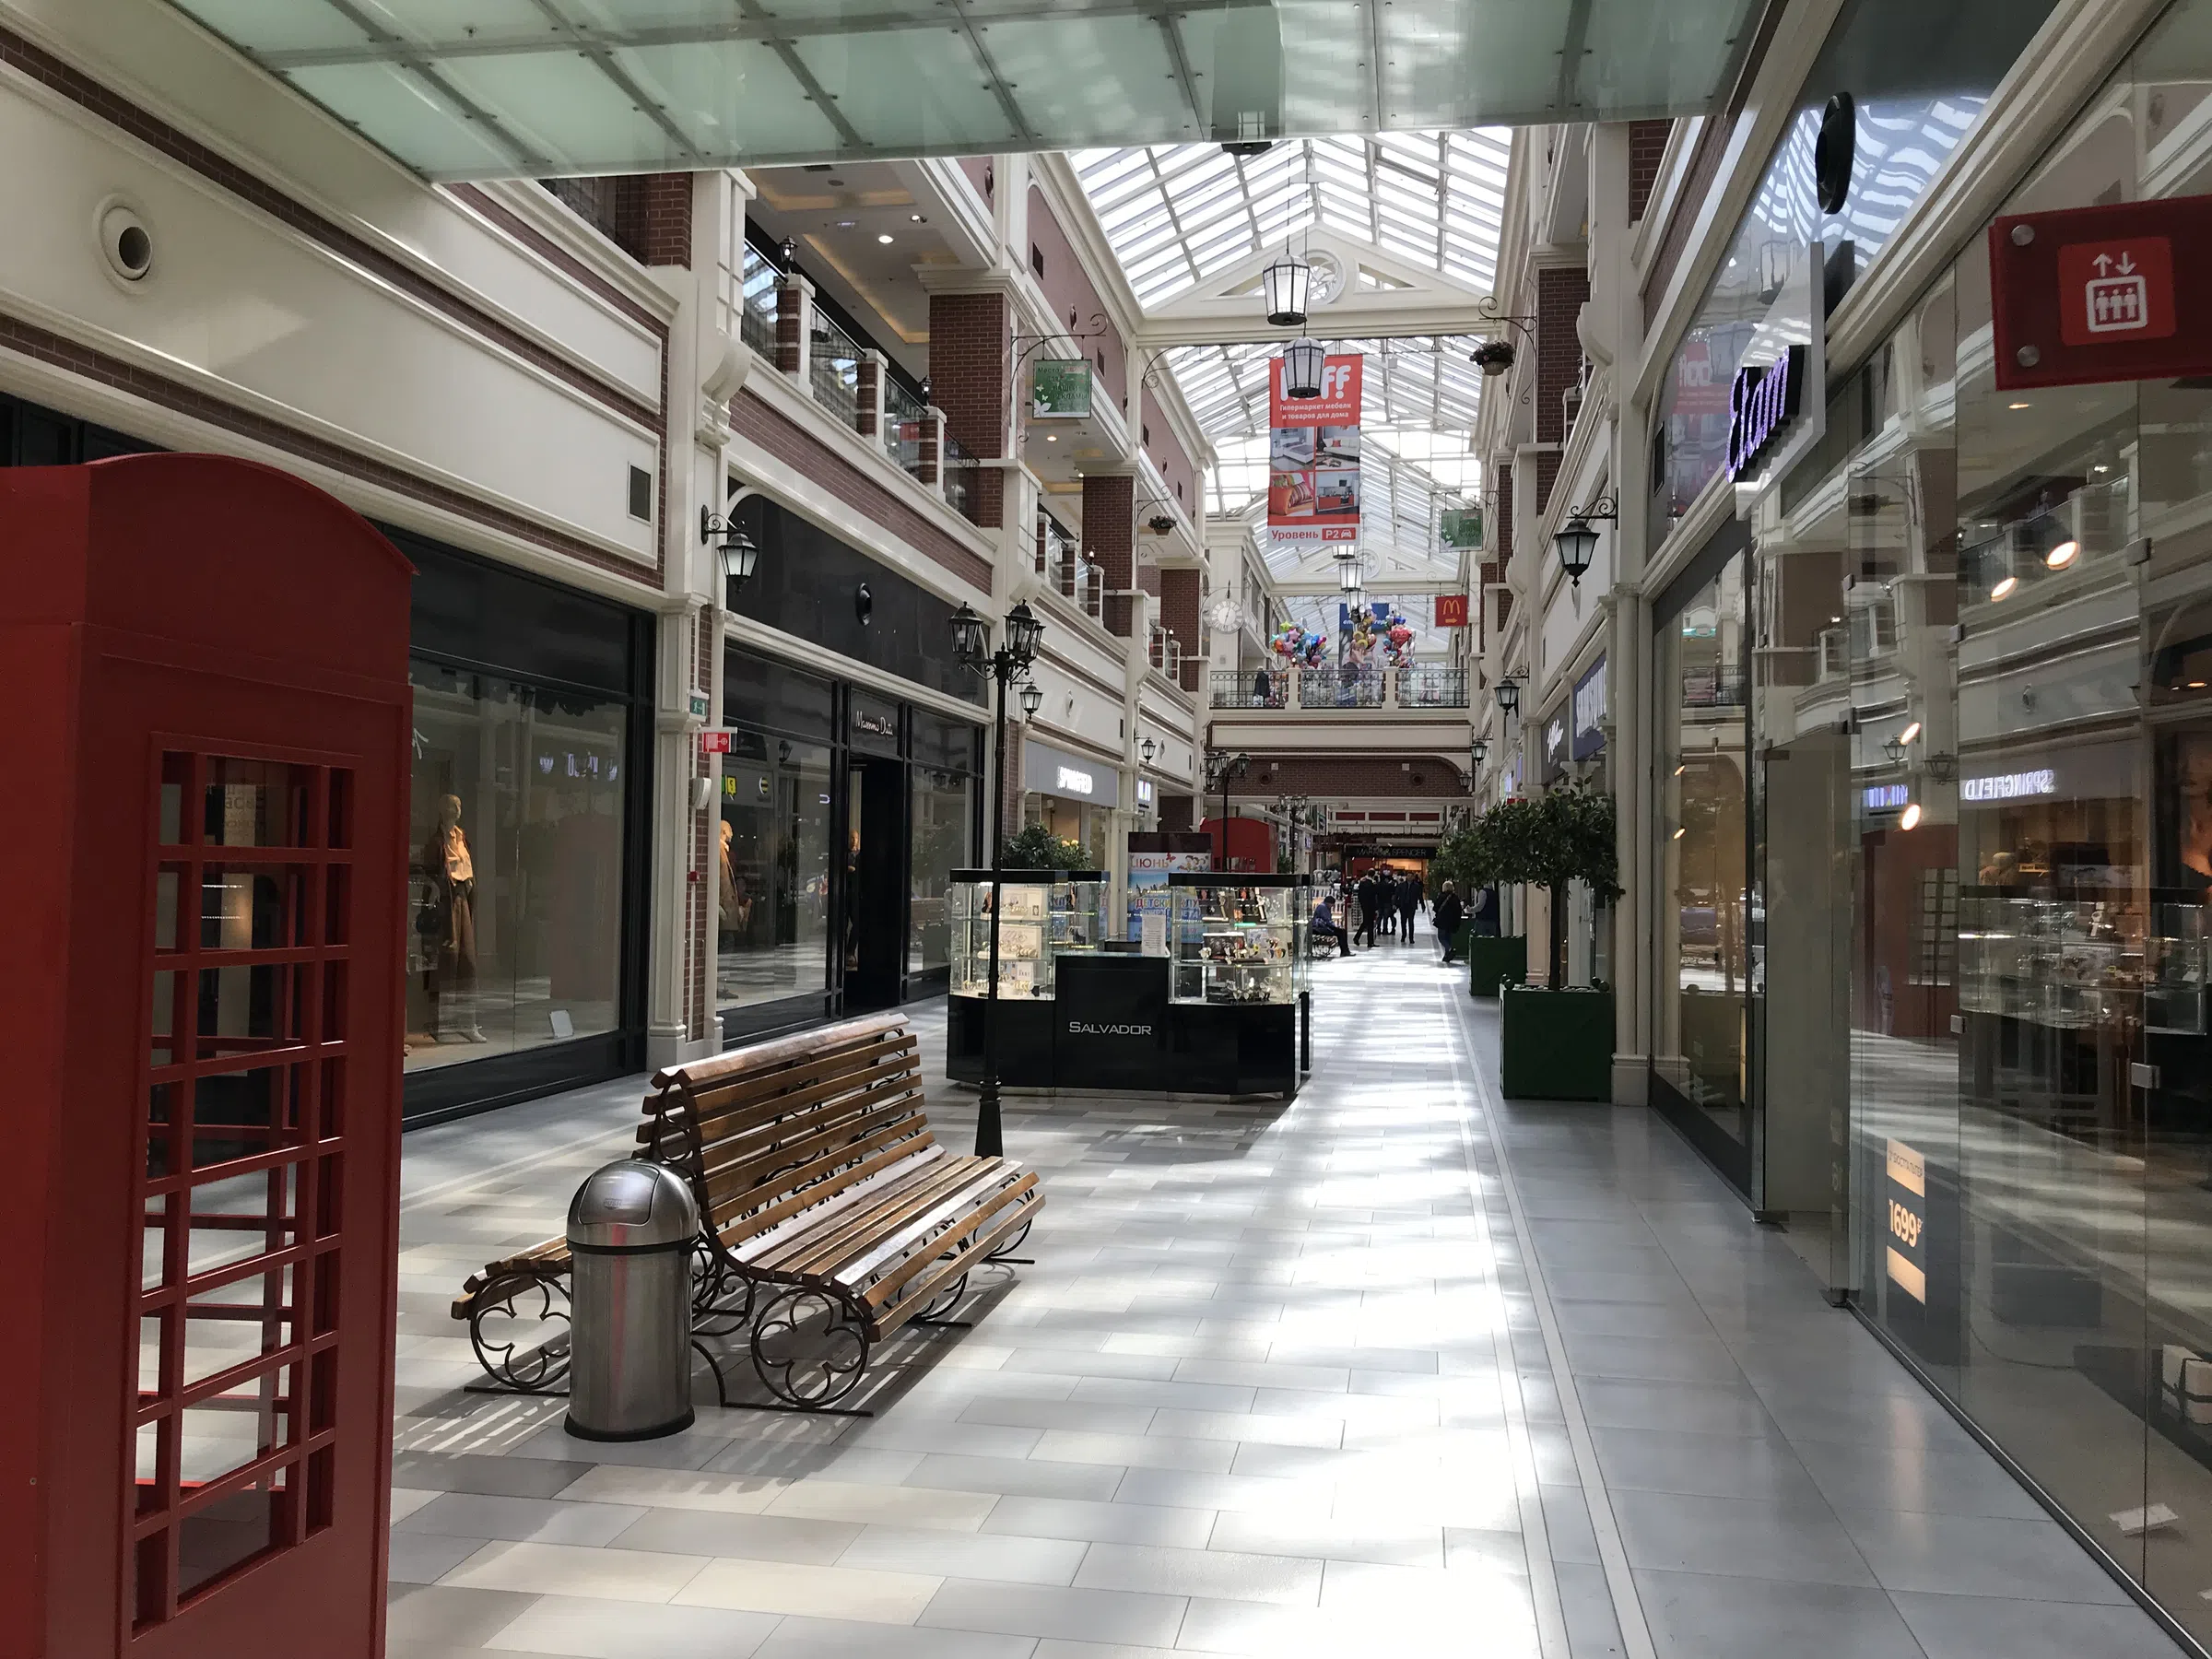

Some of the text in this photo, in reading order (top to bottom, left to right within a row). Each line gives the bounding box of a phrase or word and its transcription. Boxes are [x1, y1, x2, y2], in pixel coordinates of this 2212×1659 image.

[1279, 402, 1352, 412] Гипермаркет мебели
[1271, 529, 1319, 542] Уровень
[855, 710, 880, 732] Massimo
[1392, 848, 1427, 857] SPENCER
[1135, 898, 1171, 910] ДЕТСКИ
[1069, 1021, 1152, 1035] SALVADOR
